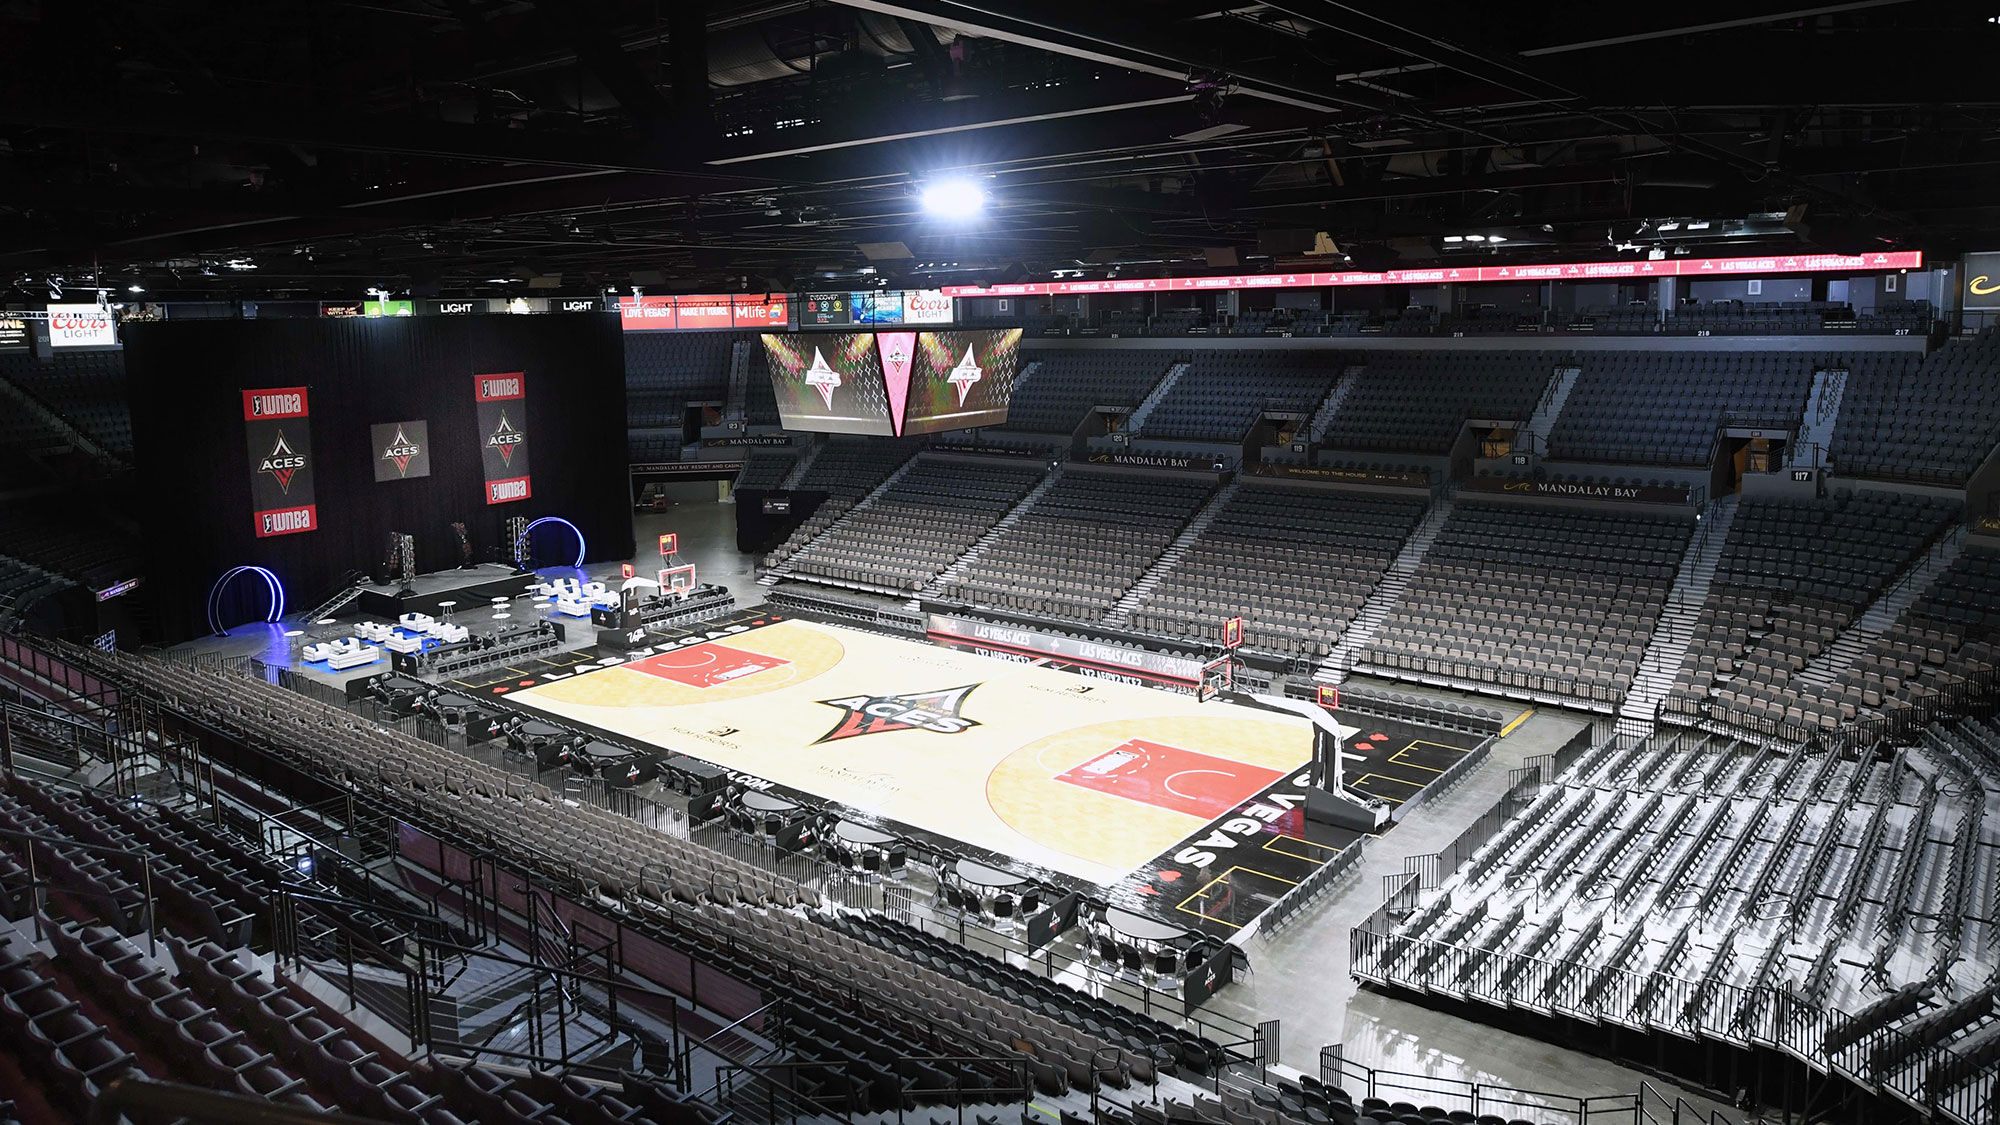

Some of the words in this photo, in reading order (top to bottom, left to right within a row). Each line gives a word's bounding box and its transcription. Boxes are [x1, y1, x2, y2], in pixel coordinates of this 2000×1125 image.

[1757, 260, 1775, 268] ACES
[1806, 258, 1820, 268] LAS
[1820, 258, 1845, 266] VEGAS
[1845, 256, 1864, 266] ACES
[1618, 265, 1634, 273] ACES
[440, 304, 472, 312] LIGHT
[563, 302, 592, 310] LIGHT
[910, 296, 950, 310] Coors
[624, 308, 643, 318] LOVE
[644, 308, 670, 318] VEGAS?
[680, 308, 698, 316] MAKE
[918, 310, 942, 318] LIGHT
[64, 330, 98, 338] LIGHT
[489, 378, 519, 396] WNBA
[262, 394, 302, 414] WNBA
[490, 434, 522, 445] ACES
[385, 446, 418, 458] ACES
[262, 456, 304, 470] ACES
[1114, 455, 1168, 466] MANDALAY
[1171, 459, 1189, 467] BAY
[1514, 456, 1526, 464] 118
[1794, 472, 1808, 480] 117
[498, 480, 526, 499] WNBA
[1538, 483, 1610, 498] MANDALAY
[1614, 488, 1639, 498] BAY
[272, 510, 310, 532] WNBA
[974, 626, 988, 637] LAS
[989, 628, 1011, 643] VEGAS
[1012, 632, 1031, 646] ACES
[1080, 644, 1096, 657] LAS
[1096, 646, 1121, 662] VEGAS
[1122, 652, 1142, 666] ACES
[541, 656, 625, 680] LAS
[828, 695, 972, 733] ACES
[1174, 792, 1306, 868] VEGAS
